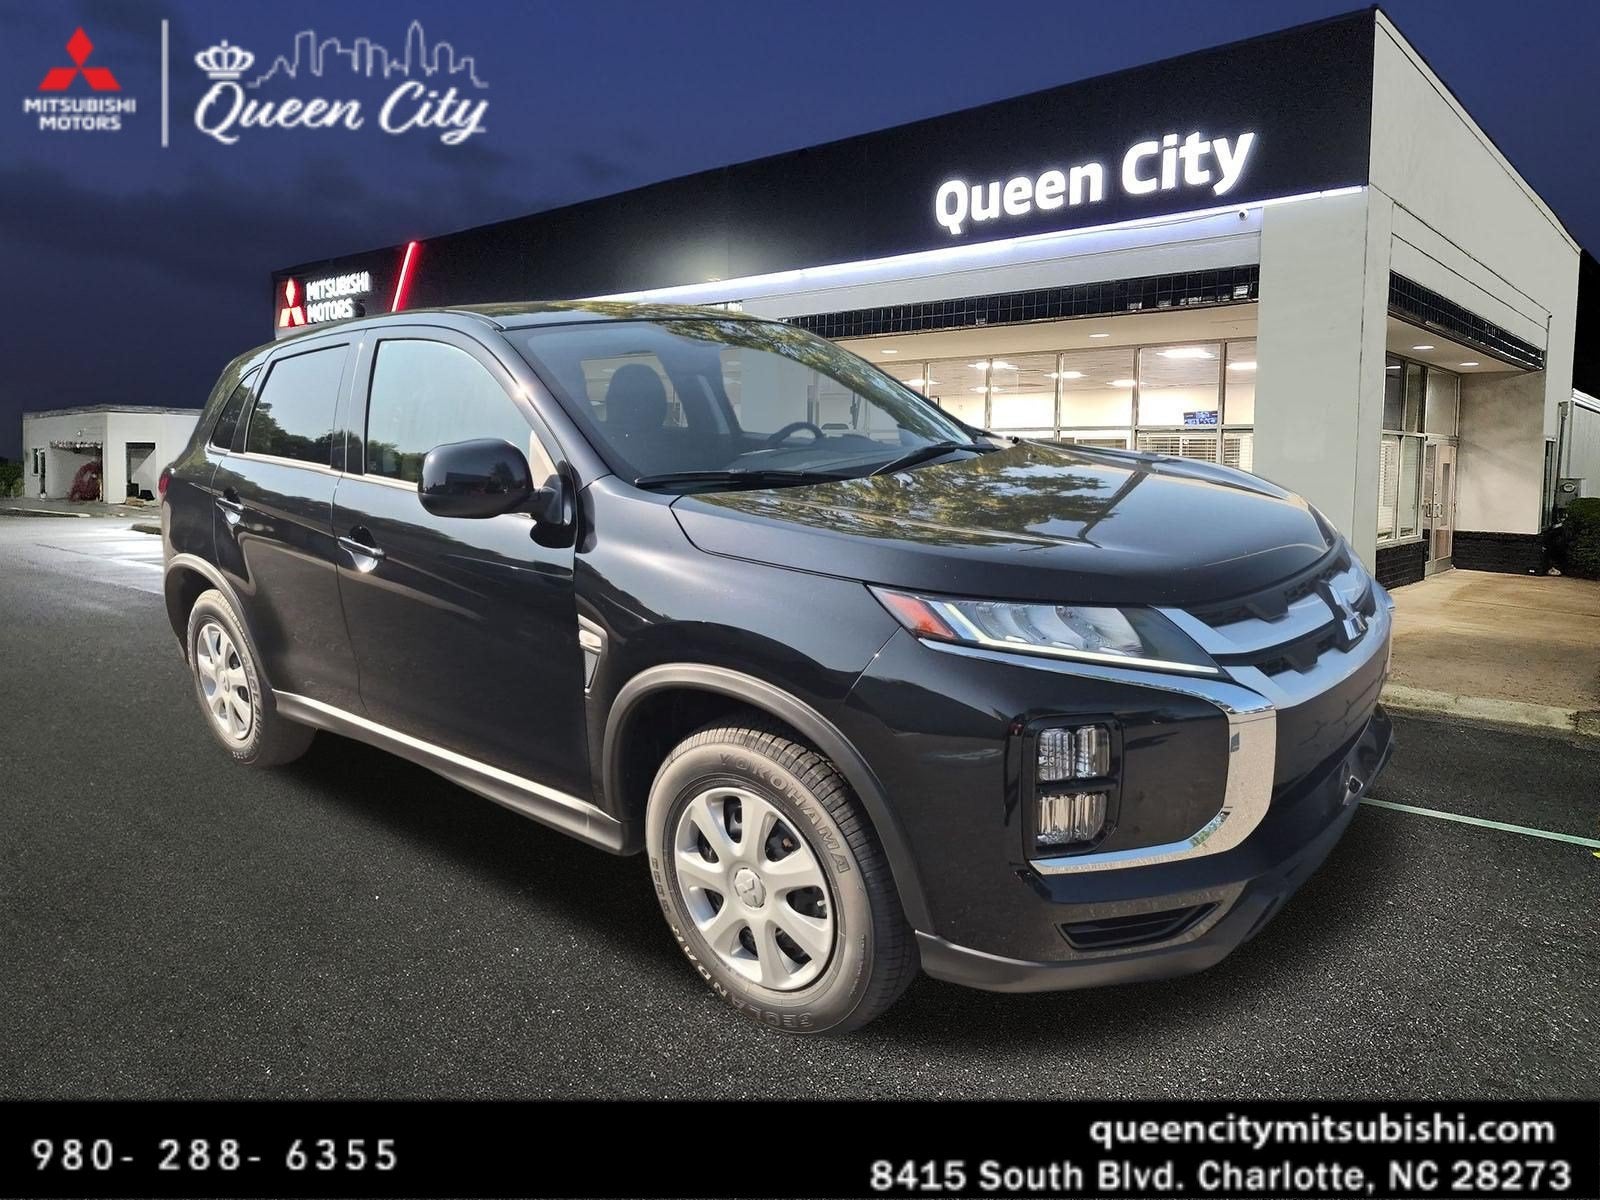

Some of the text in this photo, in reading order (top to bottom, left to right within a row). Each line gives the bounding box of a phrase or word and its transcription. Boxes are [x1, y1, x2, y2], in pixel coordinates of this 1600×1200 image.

[935, 131, 1256, 235] Queen City
[306, 270, 371, 301] MITSUBISHI
[306, 297, 354, 323] MOTORS
[719, 752, 851, 875] YOKOHAMA
